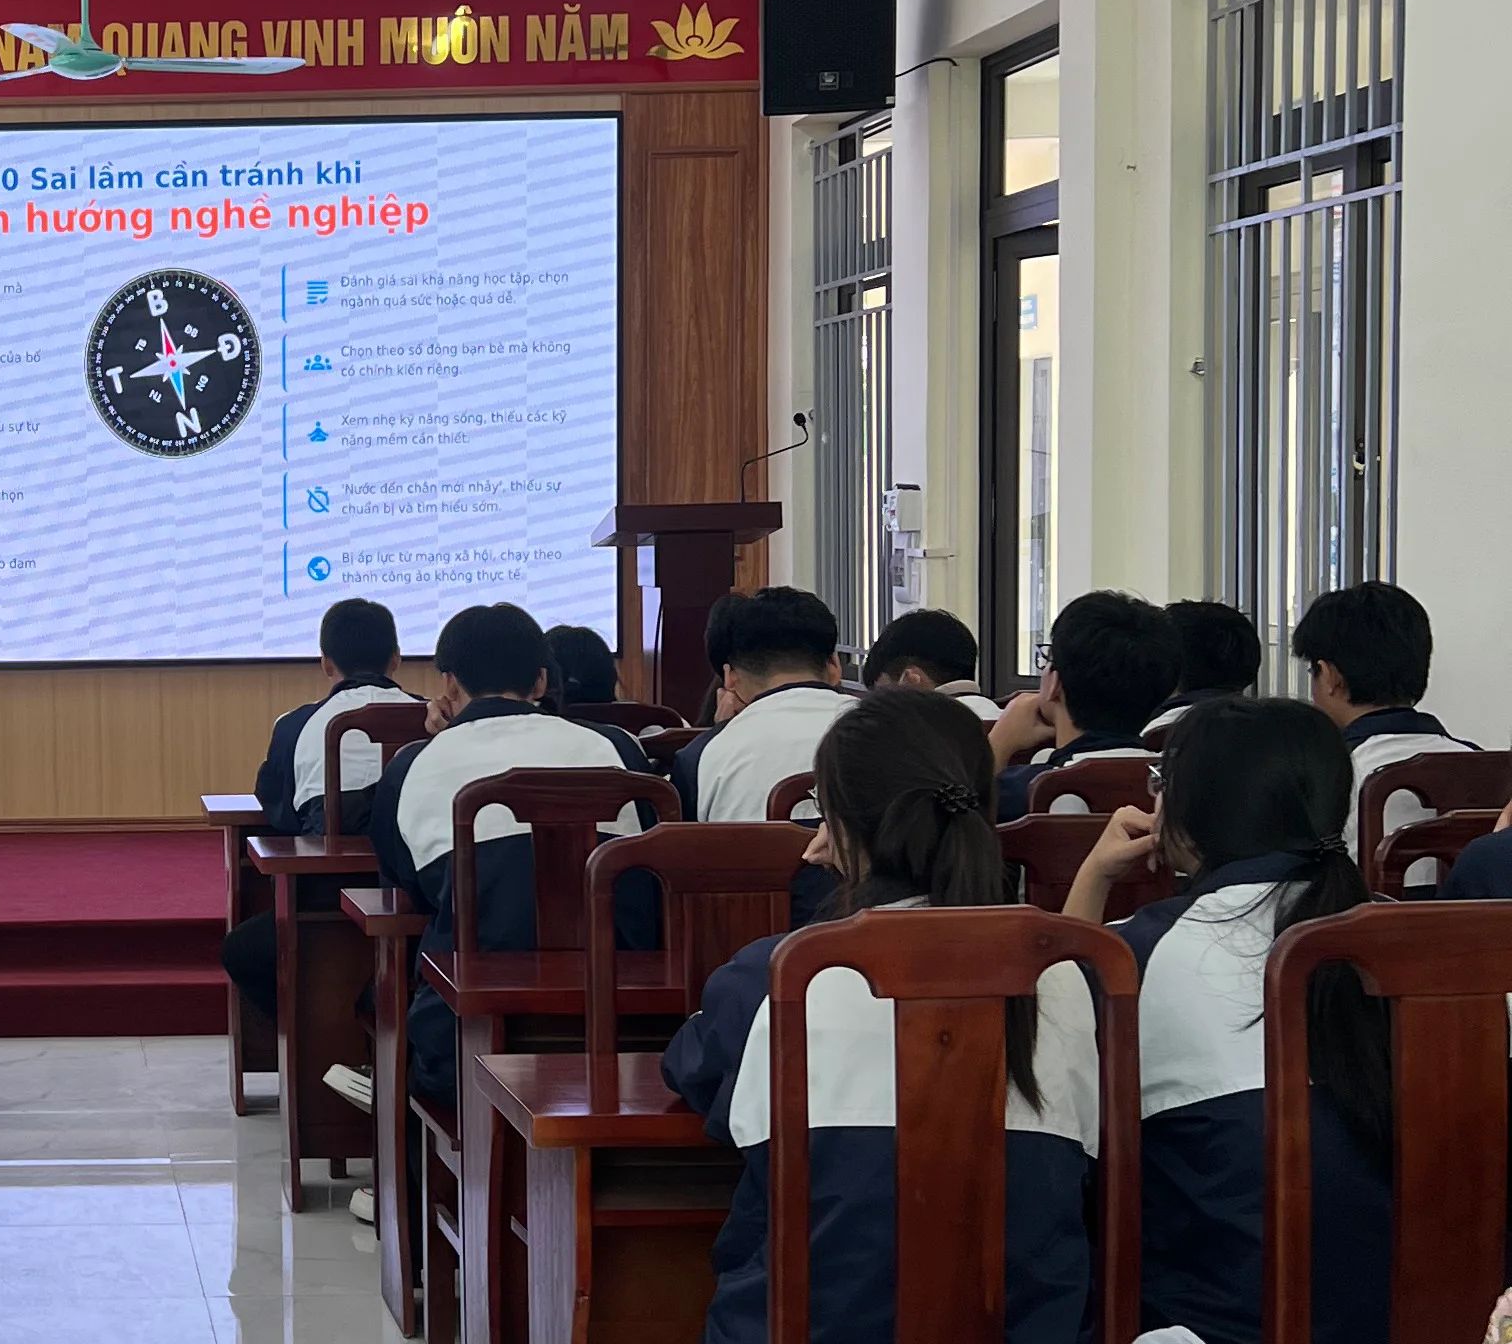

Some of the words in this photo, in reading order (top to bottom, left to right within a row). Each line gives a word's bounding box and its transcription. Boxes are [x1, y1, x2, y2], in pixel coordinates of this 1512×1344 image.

[102, 20, 248, 76] QUANG
[261, 19, 364, 67] VINH
[381, 5, 510, 65] MUÔN
[526, 3, 628, 61] NĂM
[31, 167, 76, 191] Sai
[89, 161, 143, 189] lầm
[155, 161, 208, 188] cần
[220, 161, 303, 187] tránh
[317, 160, 362, 185] khi
[27, 200, 153, 239] hướng
[171, 193, 271, 238] nghề
[288, 193, 430, 236] nghiệp
[3, 280, 22, 293] mà
[339, 275, 373, 287] Đánh
[377, 275, 396, 290] giá
[400, 275, 417, 286] sai
[422, 274, 444, 286] khả
[448, 274, 479, 289] năng
[483, 274, 506, 287] học
[538, 272, 568, 286] chọn
[147, 289, 168, 317] B
[340, 295, 379, 311] ngành
[383, 294, 406, 310] quá
[410, 294, 432, 306] sức
[436, 293, 465, 308] hoặc
[469, 292, 492, 308] quá
[0, 350, 21, 363] của
[25, 348, 40, 363] bố
[217, 333, 241, 361] Đ
[340, 345, 372, 359] Chọn
[376, 345, 404, 356] theo
[408, 342, 422, 356] số
[426, 343, 457, 359] đông
[462, 344, 485, 357] bạn
[488, 343, 504, 354] bè
[508, 342, 528, 354] mà
[532, 342, 570, 357] không
[340, 365, 355, 376] có
[358, 364, 392, 376] chính
[396, 362, 423, 376] kiến
[106, 365, 123, 394] T
[8, 423, 24, 434] sự
[26, 421, 40, 434] tự
[176, 407, 202, 438] N
[340, 414, 368, 425] Xem
[372, 413, 396, 427] nhẹ
[399, 412, 414, 428] kỹ
[418, 412, 448, 427] năng
[490, 409, 522, 423] thiếu
[526, 410, 548, 422] các
[552, 410, 566, 425] kỹ
[340, 434, 371, 449] năng
[376, 431, 407, 445] mềm
[411, 430, 434, 444] cần
[379, 480, 403, 494] đến
[406, 482, 437, 493] chân
[440, 481, 464, 493] mới
[510, 478, 542, 492] thiếu
[546, 483, 561, 494] sự
[341, 500, 379, 514] chuẩn
[383, 502, 394, 516] bị
[398, 502, 412, 513] và
[417, 501, 437, 513] tìm
[440, 499, 468, 512] hiểu
[9, 557, 36, 569] đam
[342, 551, 353, 565] Bị
[357, 550, 372, 566] áp
[376, 551, 395, 564] lực
[398, 550, 412, 562] từ
[415, 553, 450, 565] mạng
[454, 549, 469, 561] xã
[500, 549, 530, 564] chạy
[533, 548, 561, 560] theo
[341, 570, 378, 582] thành
[381, 570, 411, 585] công
[415, 569, 430, 581] ảo
[434, 569, 472, 584] không
[476, 569, 504, 583] thực
